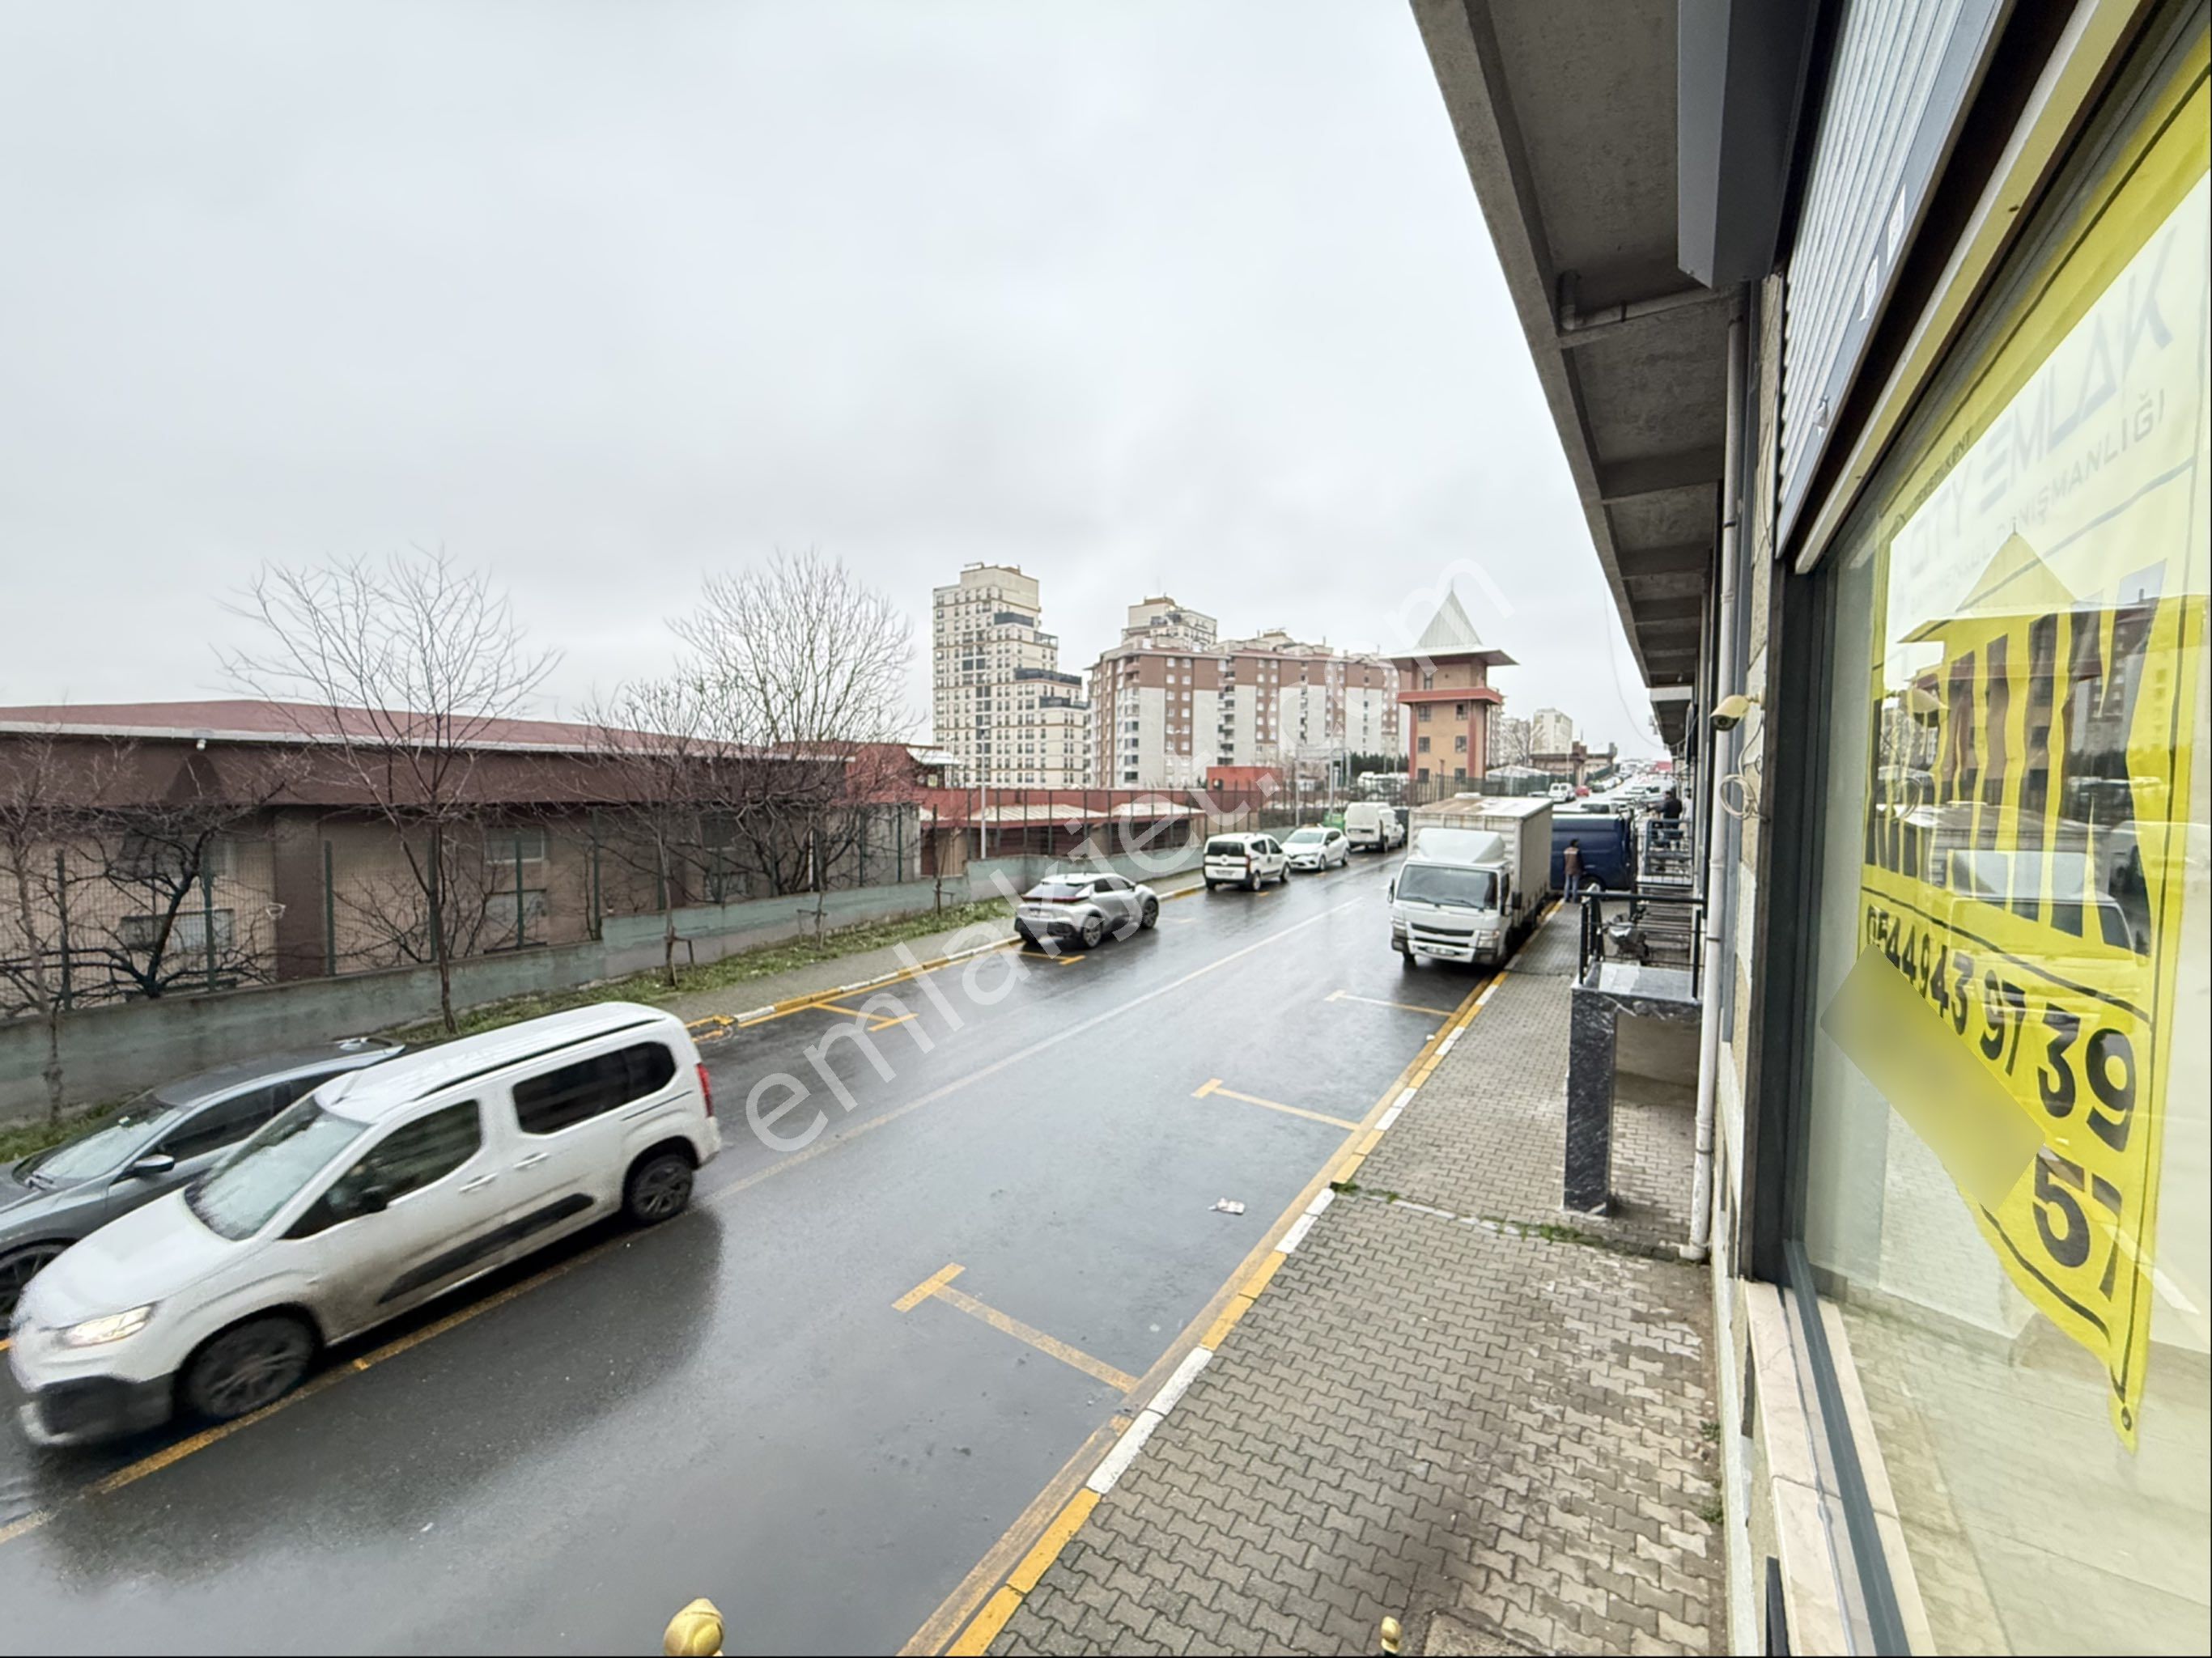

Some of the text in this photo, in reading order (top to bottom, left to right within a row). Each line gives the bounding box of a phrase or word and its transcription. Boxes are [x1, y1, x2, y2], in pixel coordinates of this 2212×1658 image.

[1980, 224, 2178, 515] EMLAK
[1979, 969, 2027, 1078] 97
[2037, 1001, 2137, 1153] 39
[2032, 1147, 2123, 1302] 57
